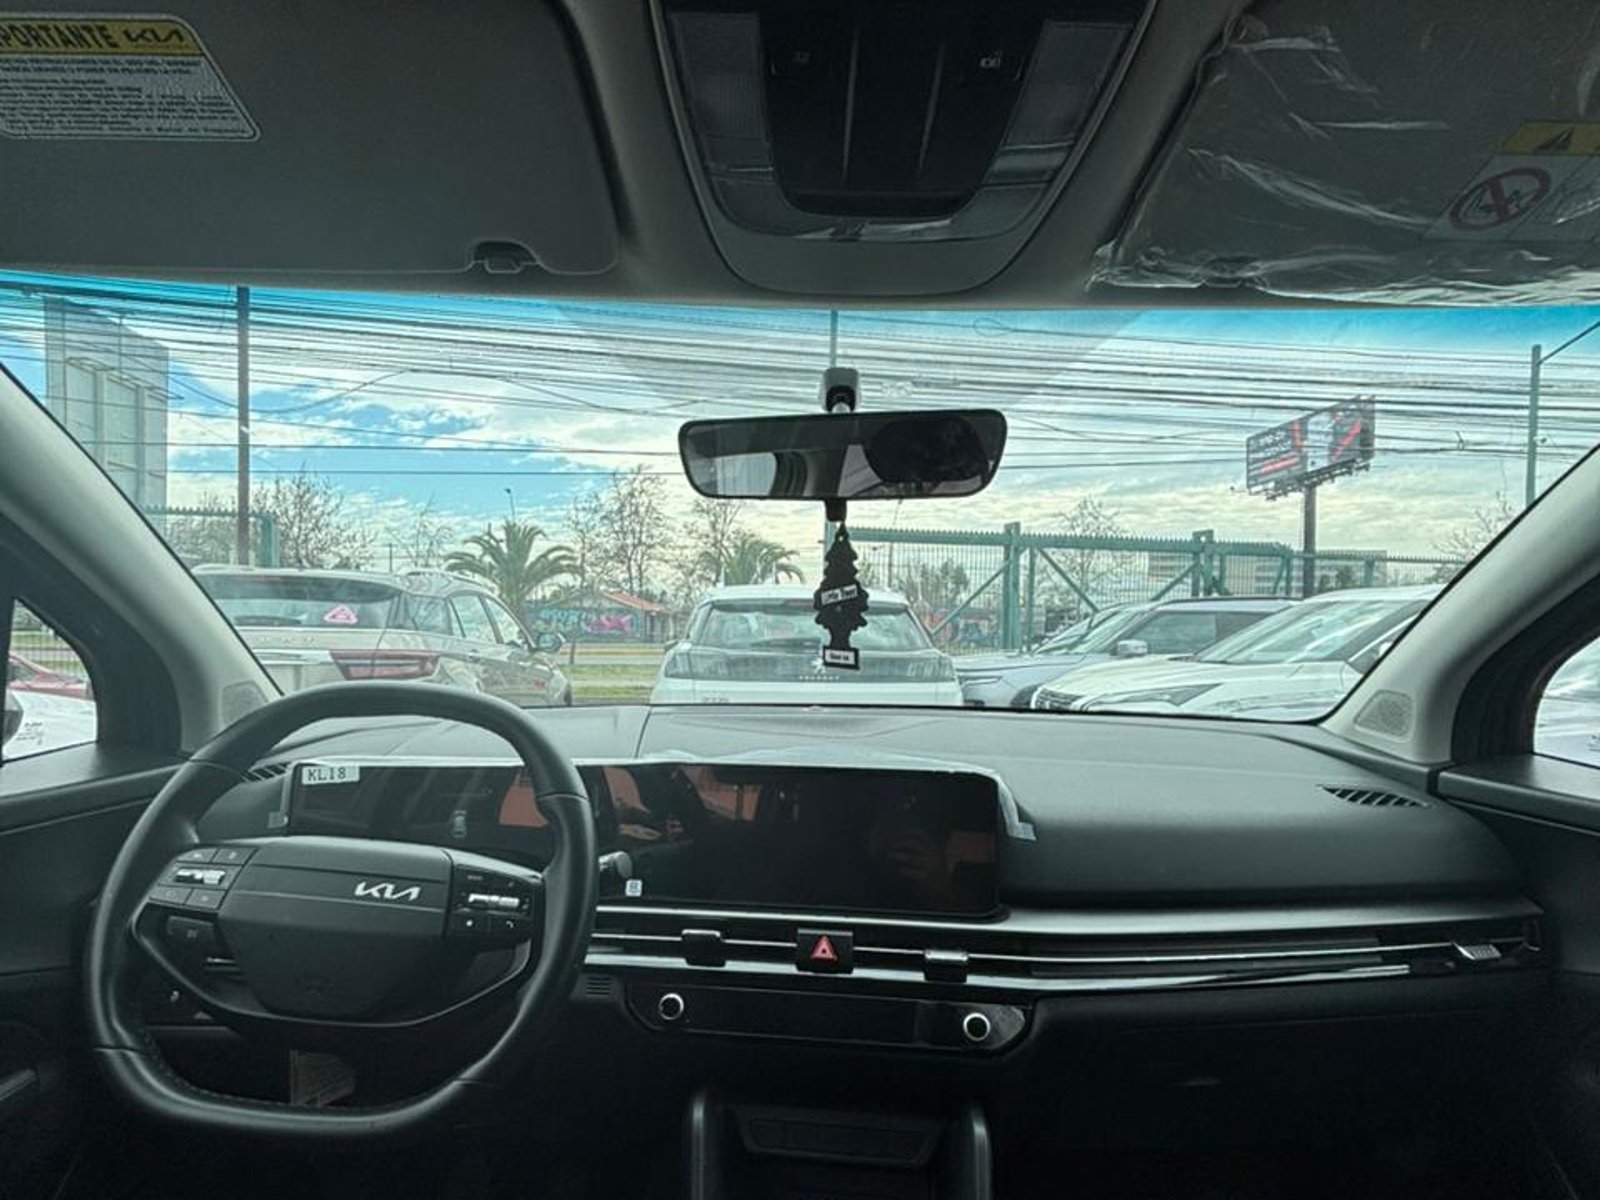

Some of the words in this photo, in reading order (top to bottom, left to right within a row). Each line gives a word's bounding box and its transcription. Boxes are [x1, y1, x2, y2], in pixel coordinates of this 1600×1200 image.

[0, 23, 119, 48] PORTANTE
[123, 28, 184, 43] KIA
[354, 881, 421, 901] KIA
